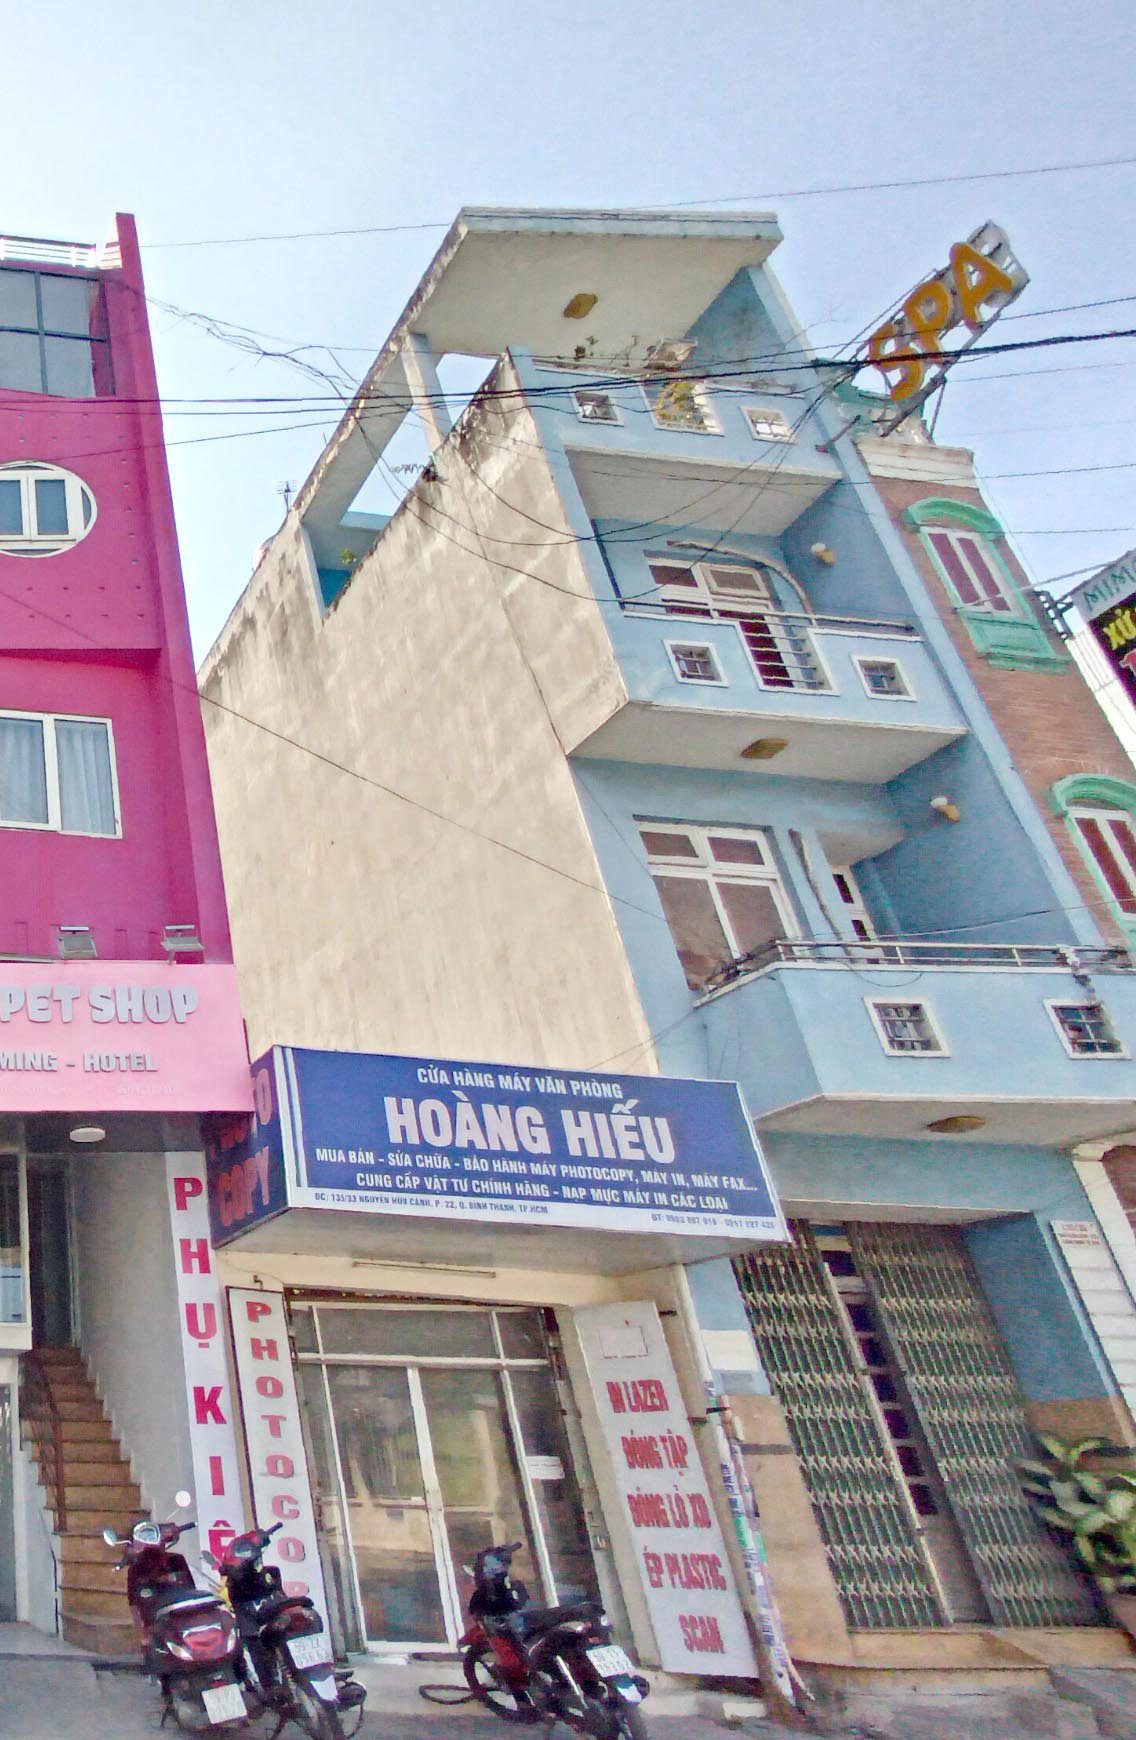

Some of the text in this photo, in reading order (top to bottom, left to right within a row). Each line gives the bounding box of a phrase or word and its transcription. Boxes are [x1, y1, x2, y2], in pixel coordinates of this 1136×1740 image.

[869, 241, 1014, 401] SPA
[88, 985, 199, 1025] SHOP
[83, 1051, 158, 1073] HOTEL
[417, 1066, 623, 1099] CỬA HÀNG MÁY VĂN PHÒNG
[384, 1090, 676, 1164] HOÀNG HIẾU
[316, 1147, 346, 1163] MUA
[348, 1149, 375, 1166] BÁN
[388, 1151, 412, 1168] SỬA
[415, 1153, 452, 1170] CHỮA
[493, 1157, 527, 1175] HÀNH
[530, 1159, 558, 1177] MÁY
[561, 1164, 640, 1185] PHOTOCOPY,
[641, 1167, 667, 1186] MÁY
[692, 1172, 721, 1189] MÁY
[356, 1171, 728, 1213] CUNG CẤP VẬT TƯ CHÍNH HÃNG NẠP MỰC MÁY IN CÁC LOẠI
[173, 1177, 217, 1348] PHỤ
[245, 1300, 310, 1599] PHOTOCOP
[643, 1545, 727, 1591] ÉP PLASTIC
